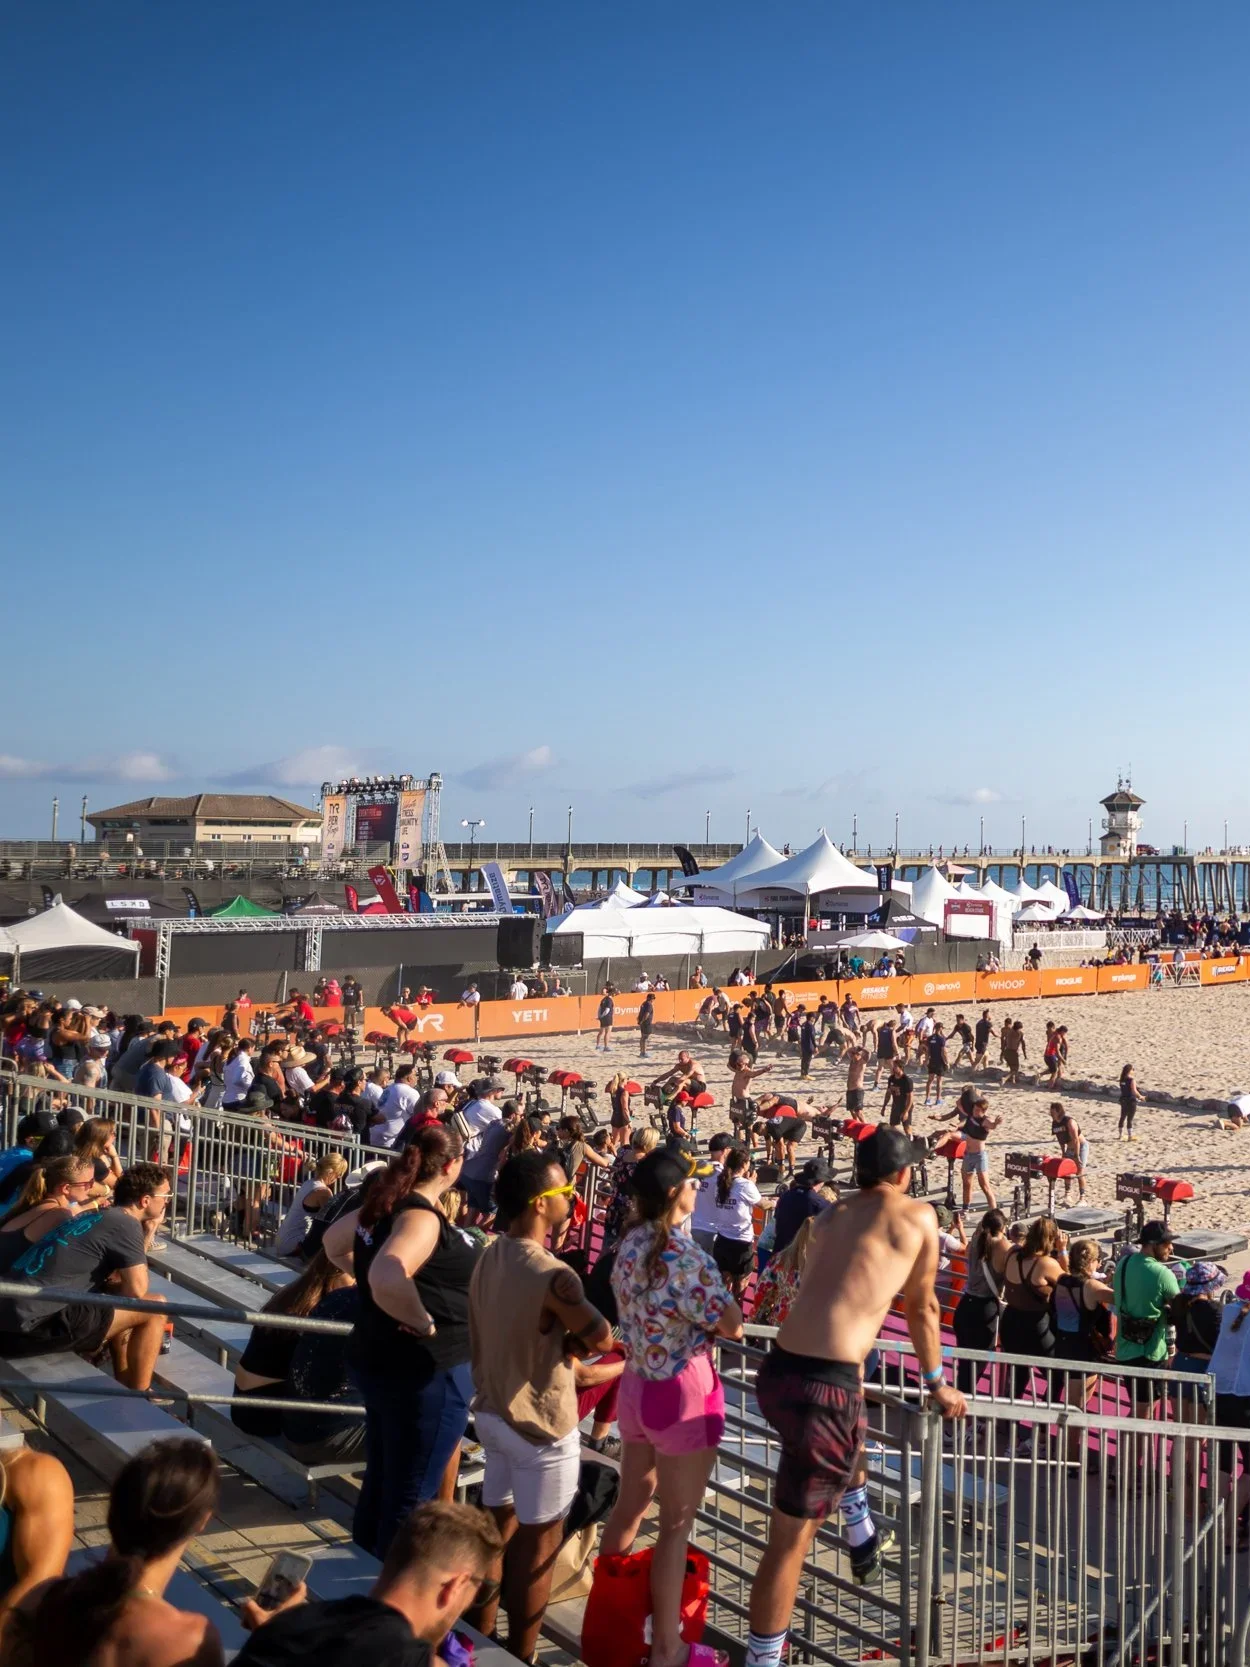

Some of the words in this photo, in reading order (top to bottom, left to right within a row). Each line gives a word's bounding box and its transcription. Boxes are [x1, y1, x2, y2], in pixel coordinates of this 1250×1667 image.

[329, 803, 340, 814] TYR
[989, 979, 1025, 990] WHOOP
[1055, 976, 1083, 986] ROGUE
[861, 985, 889, 993] ASSAULT
[511, 1009, 548, 1023] YETI
[416, 1013, 444, 1033] YR
[813, 1126, 829, 1134] ROGUE
[1007, 1164, 1028, 1172] ROGUE
[1118, 1185, 1140, 1194] ROGUE
